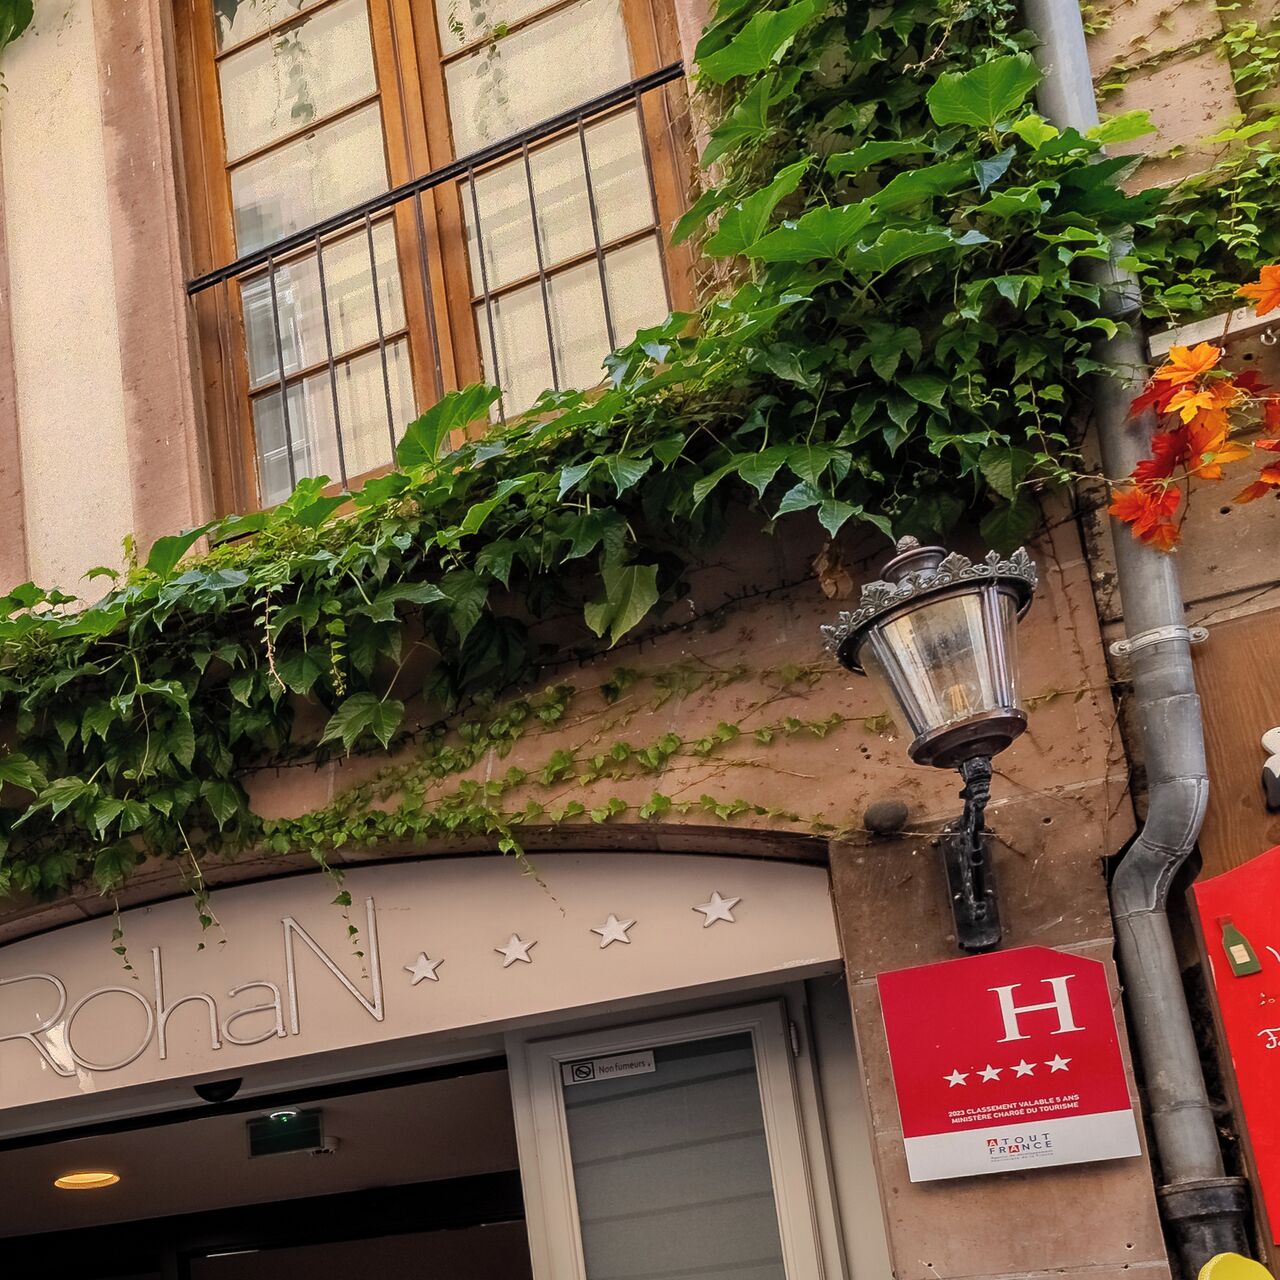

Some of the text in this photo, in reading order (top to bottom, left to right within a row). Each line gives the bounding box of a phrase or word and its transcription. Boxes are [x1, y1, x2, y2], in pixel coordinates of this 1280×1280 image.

[987, 973, 1086, 1044] H
[598, 1060, 646, 1074] Non fumeurs
[948, 1110, 965, 1118] 2023
[966, 1102, 1017, 1115] CLASSEMENT
[1018, 1097, 1054, 1108] VALABLE
[1062, 1094, 1080, 1102] ANS
[951, 1102, 1079, 1124] MINISTÈRE CHARGÉ DU TOURISME
[986, 1132, 1050, 1147] ATOUT
[989, 1140, 1052, 1155] FRANCE
